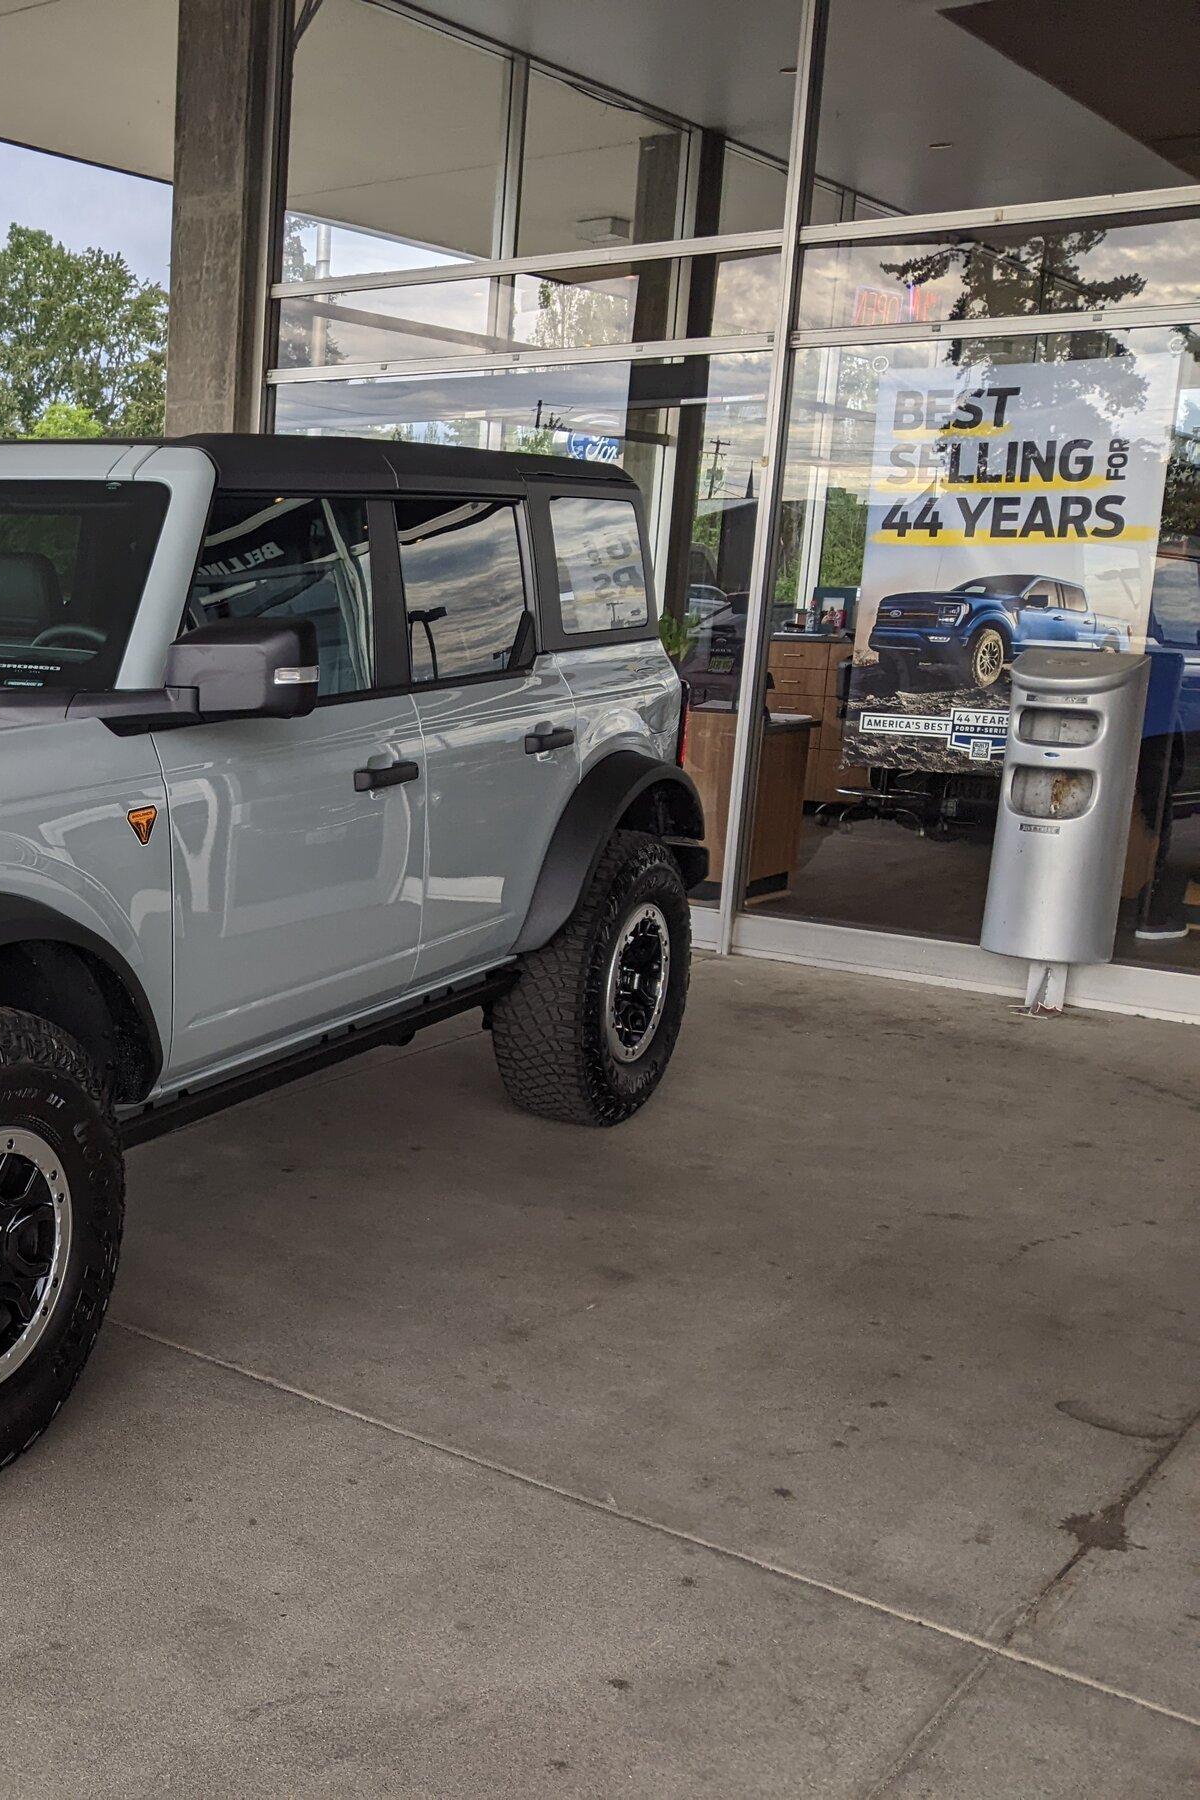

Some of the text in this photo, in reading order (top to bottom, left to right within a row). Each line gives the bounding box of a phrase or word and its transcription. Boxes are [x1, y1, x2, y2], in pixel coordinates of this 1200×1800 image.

[893, 387, 1021, 431] BEST
[886, 438, 1093, 484] SELLING
[1106, 438, 1129, 481] FOR
[881, 495, 1126, 538] 44 YEARS
[866, 718, 949, 732] AMERICA'S BEST
[956, 714, 971, 723] 44
